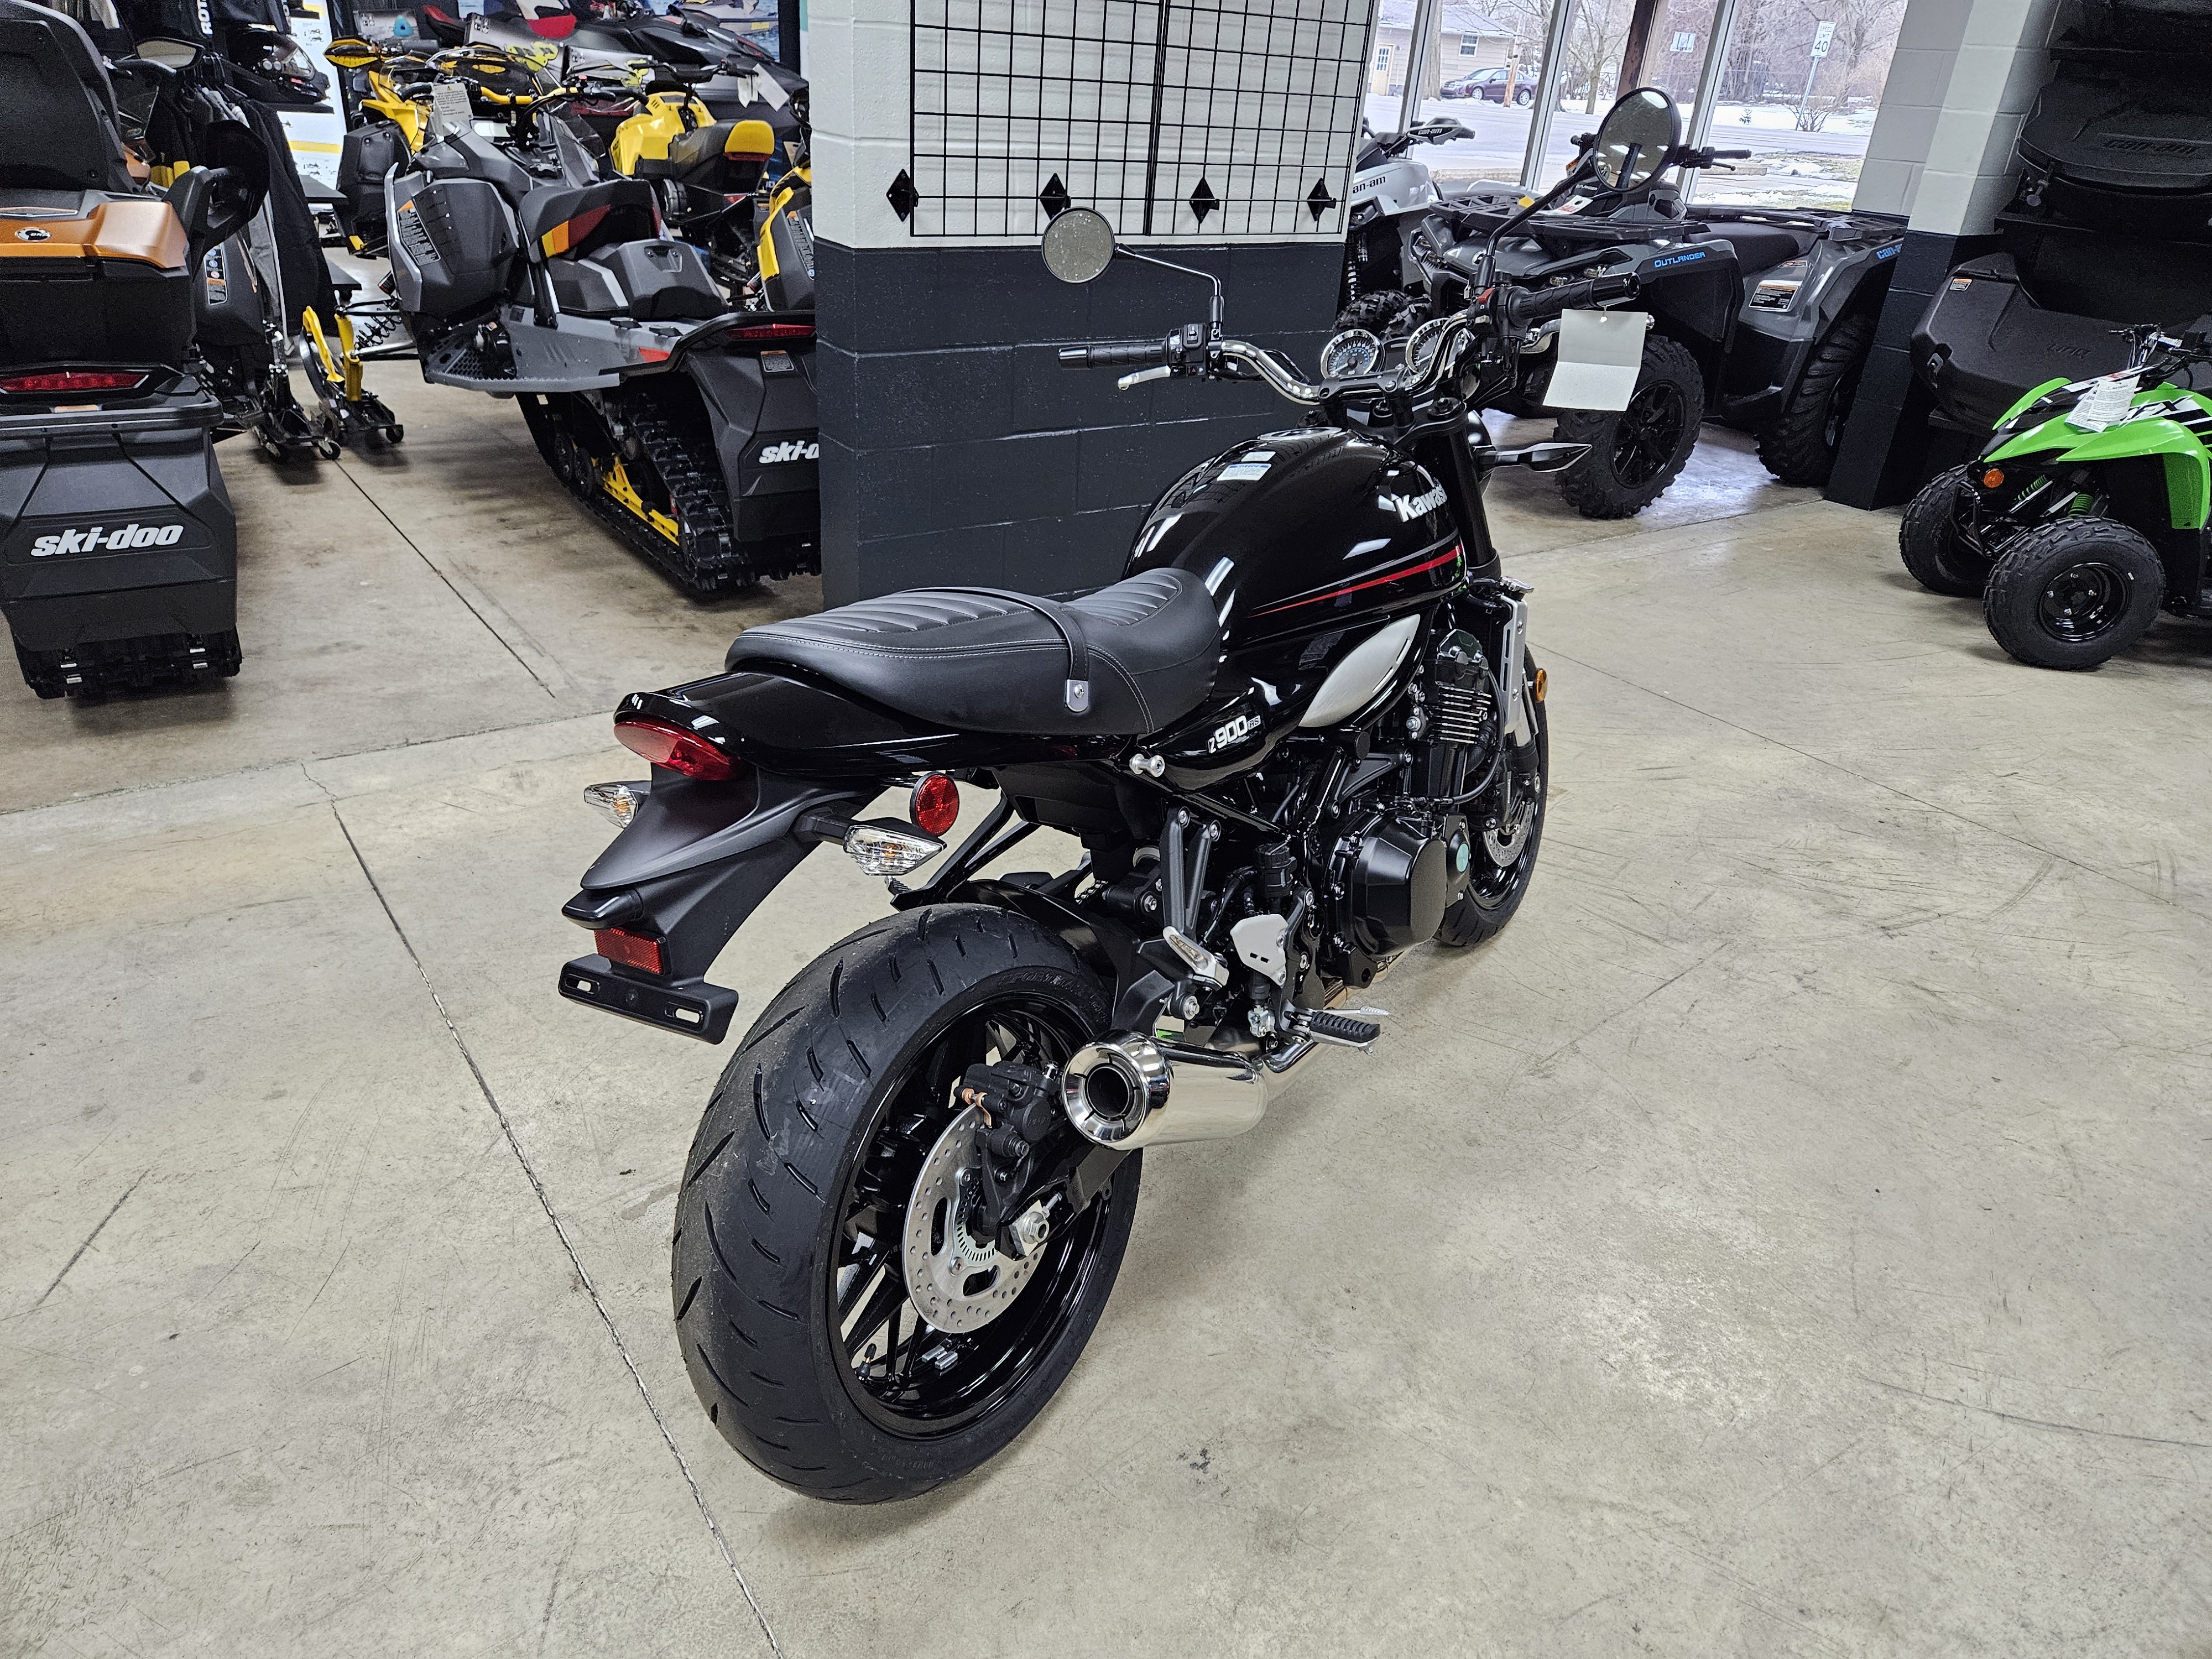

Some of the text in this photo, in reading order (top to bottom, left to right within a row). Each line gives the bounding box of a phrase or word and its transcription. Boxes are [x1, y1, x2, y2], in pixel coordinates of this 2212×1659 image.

[196, 0, 213, 34] ROT
[1814, 40, 1828, 53] 40
[1353, 176, 1386, 194] an-am
[1654, 252, 1706, 268] OUTLANDER
[30, 524, 184, 556] ski-doo
[1249, 717, 1260, 729] RS
